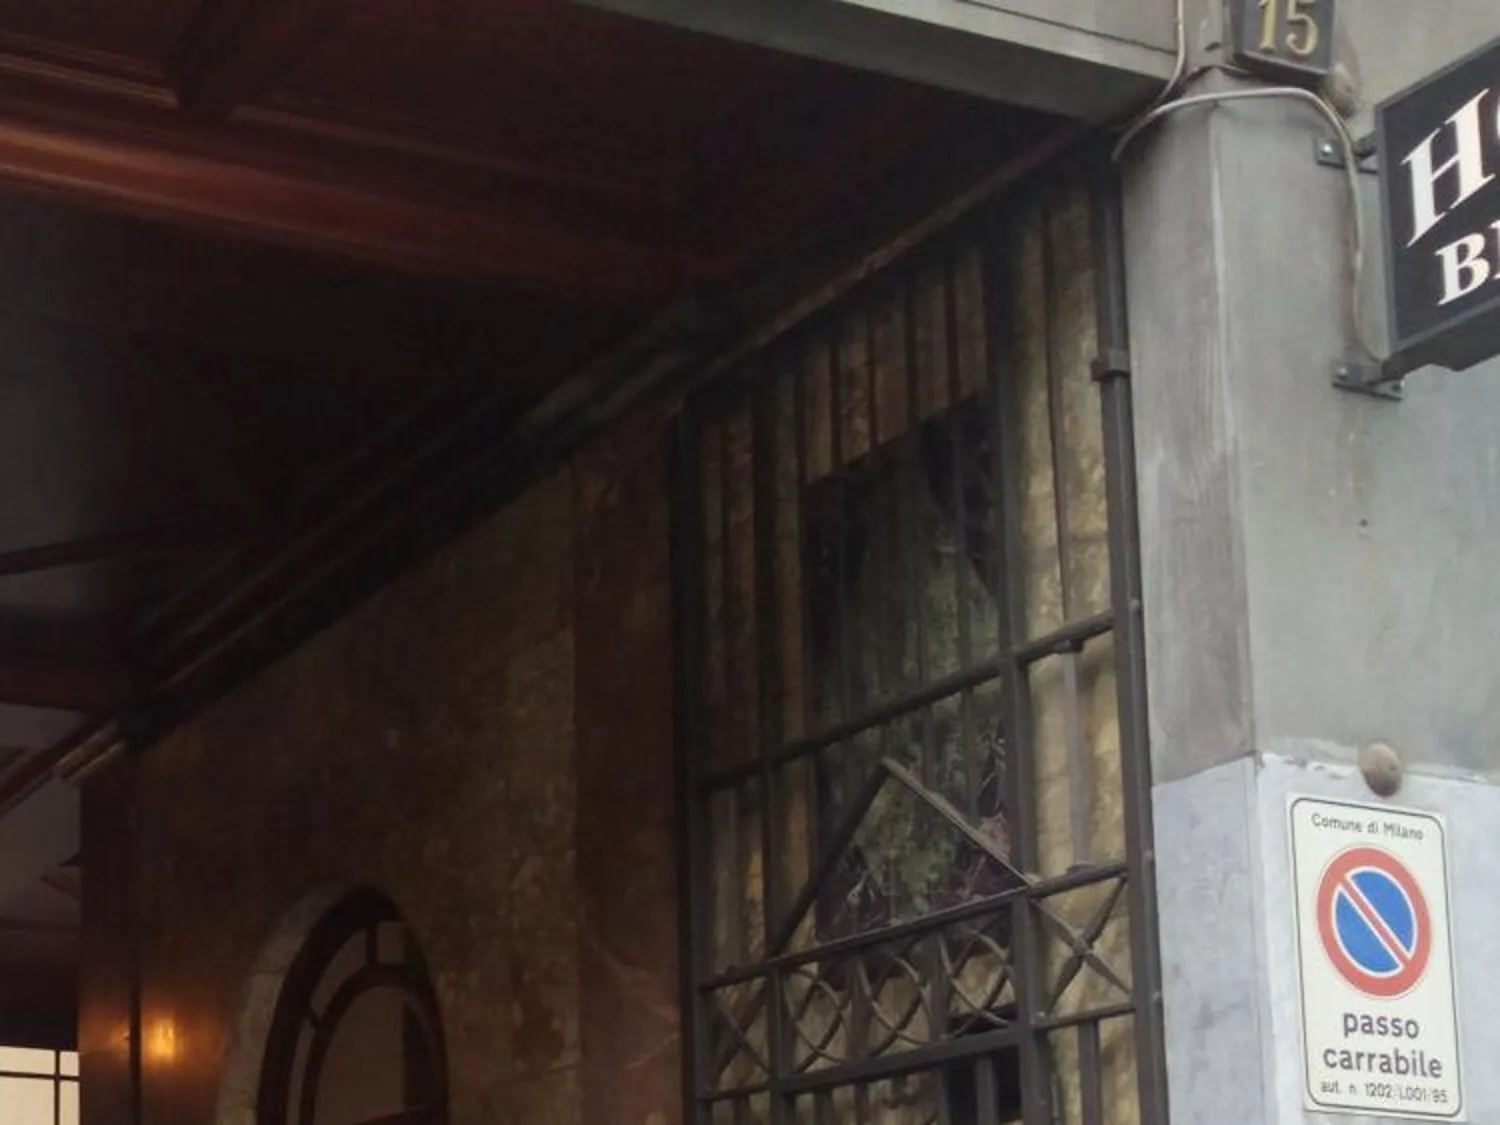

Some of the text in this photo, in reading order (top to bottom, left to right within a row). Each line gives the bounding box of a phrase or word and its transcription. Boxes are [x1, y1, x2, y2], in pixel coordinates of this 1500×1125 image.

[1257, 0, 1319, 56] 15
[1400, 88, 1500, 248] H
[1435, 219, 1500, 306] B
[1311, 812, 1425, 841] Comune di Milano
[1343, 1012, 1419, 1040] passo
[1323, 1047, 1442, 1079] carrabile
